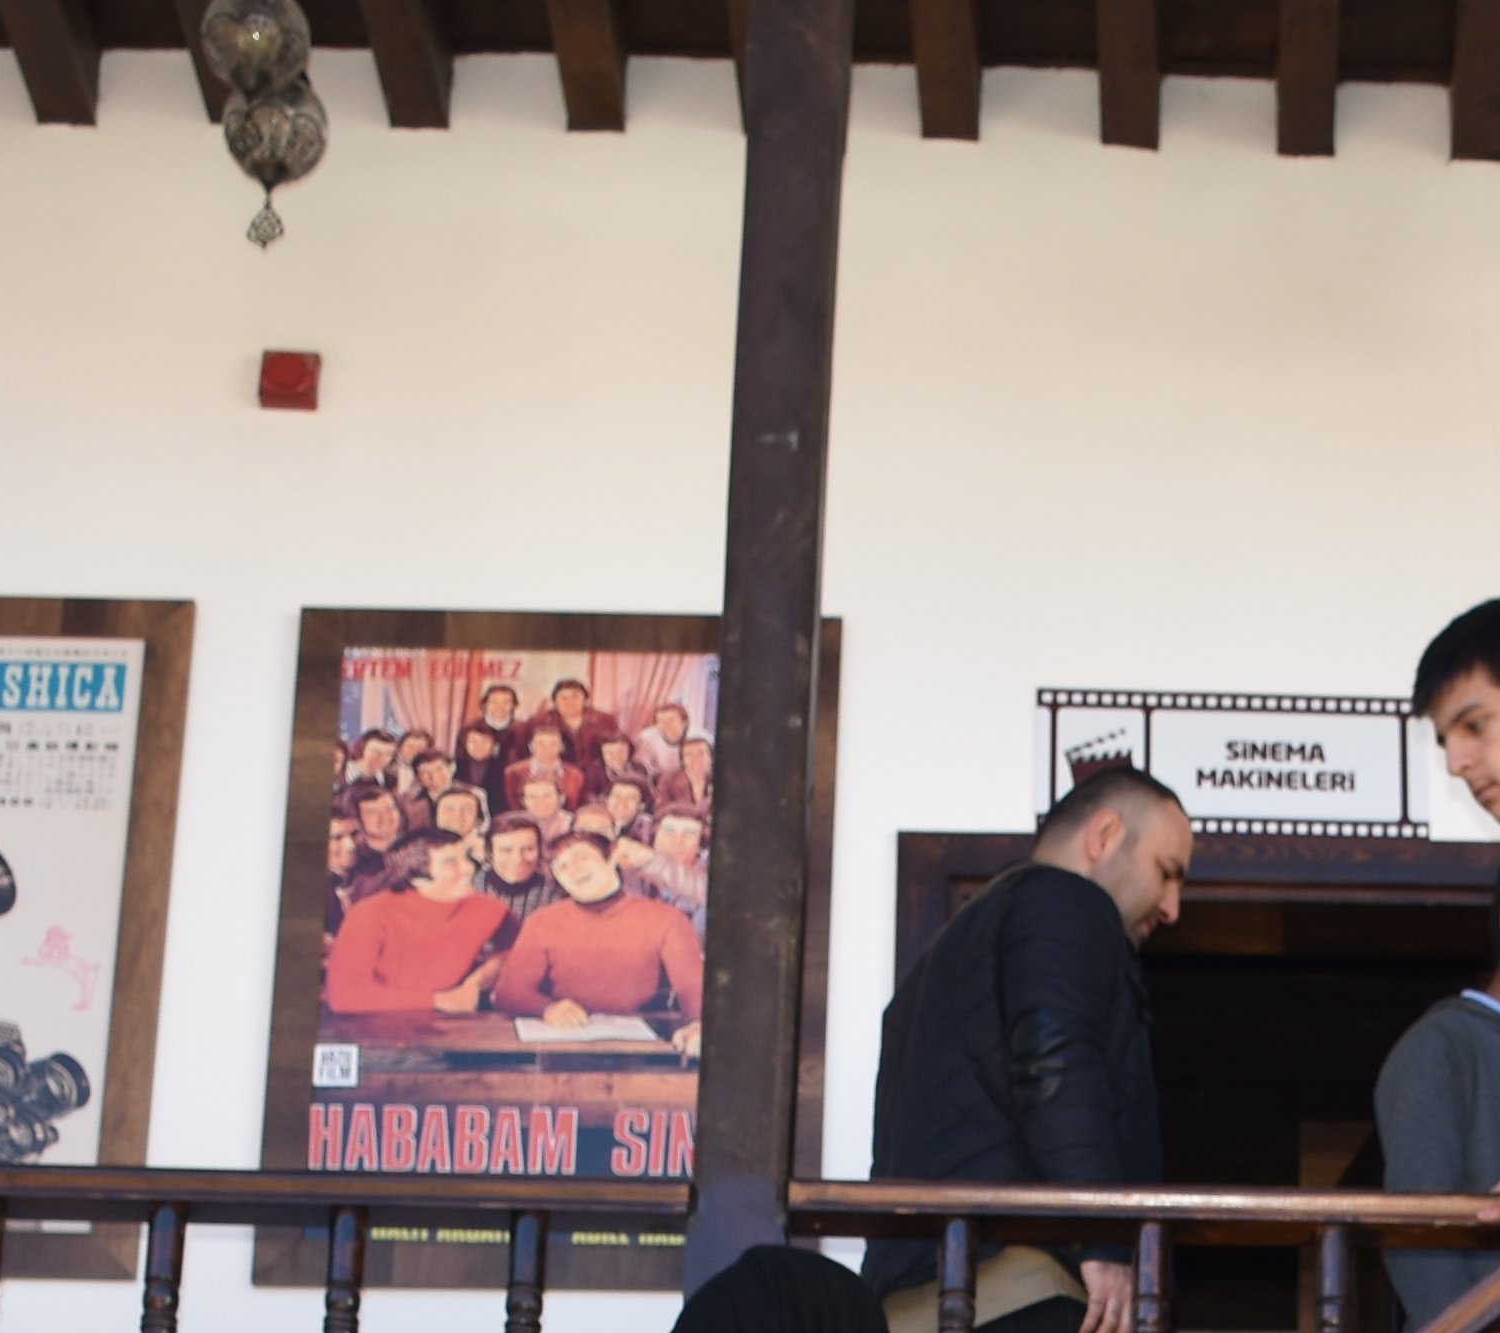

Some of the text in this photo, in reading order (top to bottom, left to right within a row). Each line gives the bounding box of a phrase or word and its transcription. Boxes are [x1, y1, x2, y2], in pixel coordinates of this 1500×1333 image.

[1224, 740, 1326, 764] SİNEMA
[1195, 767, 1356, 793] MAKİNELERİ
[307, 1102, 695, 1177] HABABAM SIN
